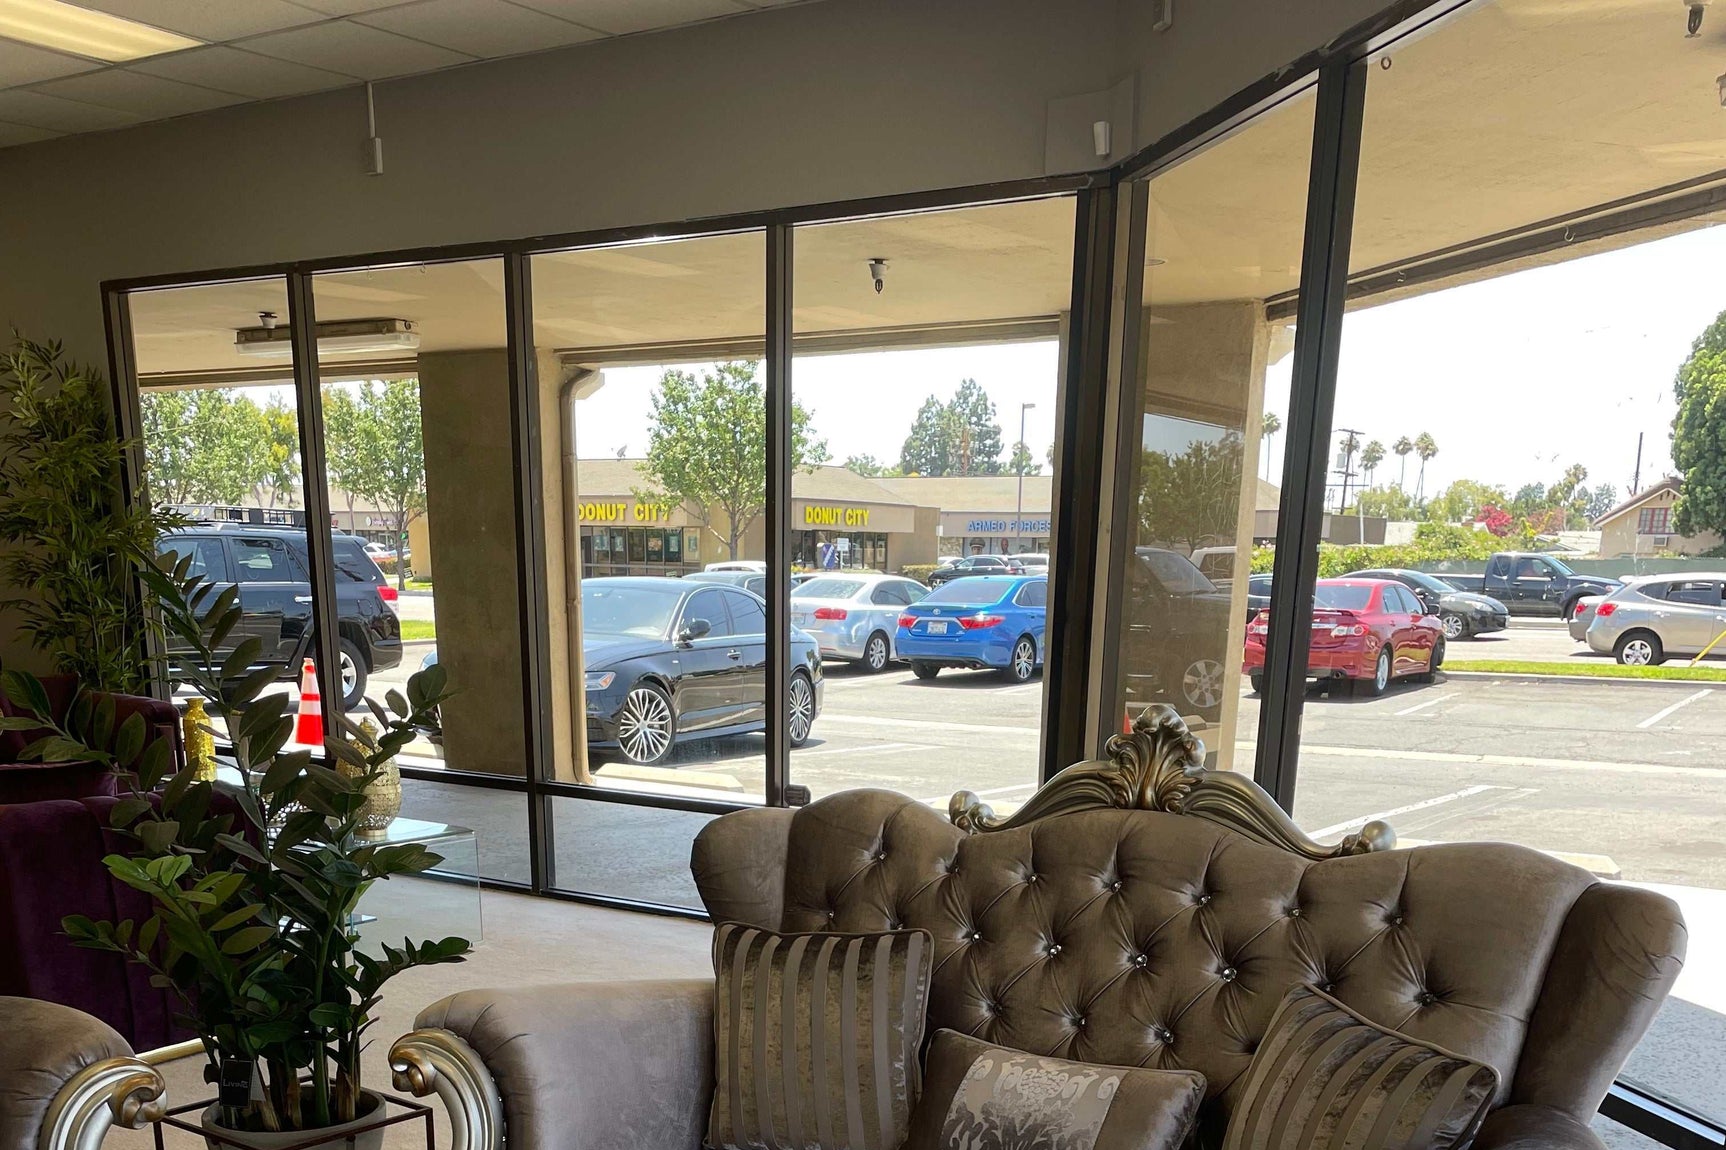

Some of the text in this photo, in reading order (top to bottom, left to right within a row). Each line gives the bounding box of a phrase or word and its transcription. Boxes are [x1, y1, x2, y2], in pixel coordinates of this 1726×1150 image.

[578, 503, 626, 520] DONUT
[805, 506, 869, 526] DONUT CITY
[967, 520, 1006, 533] ARMED
